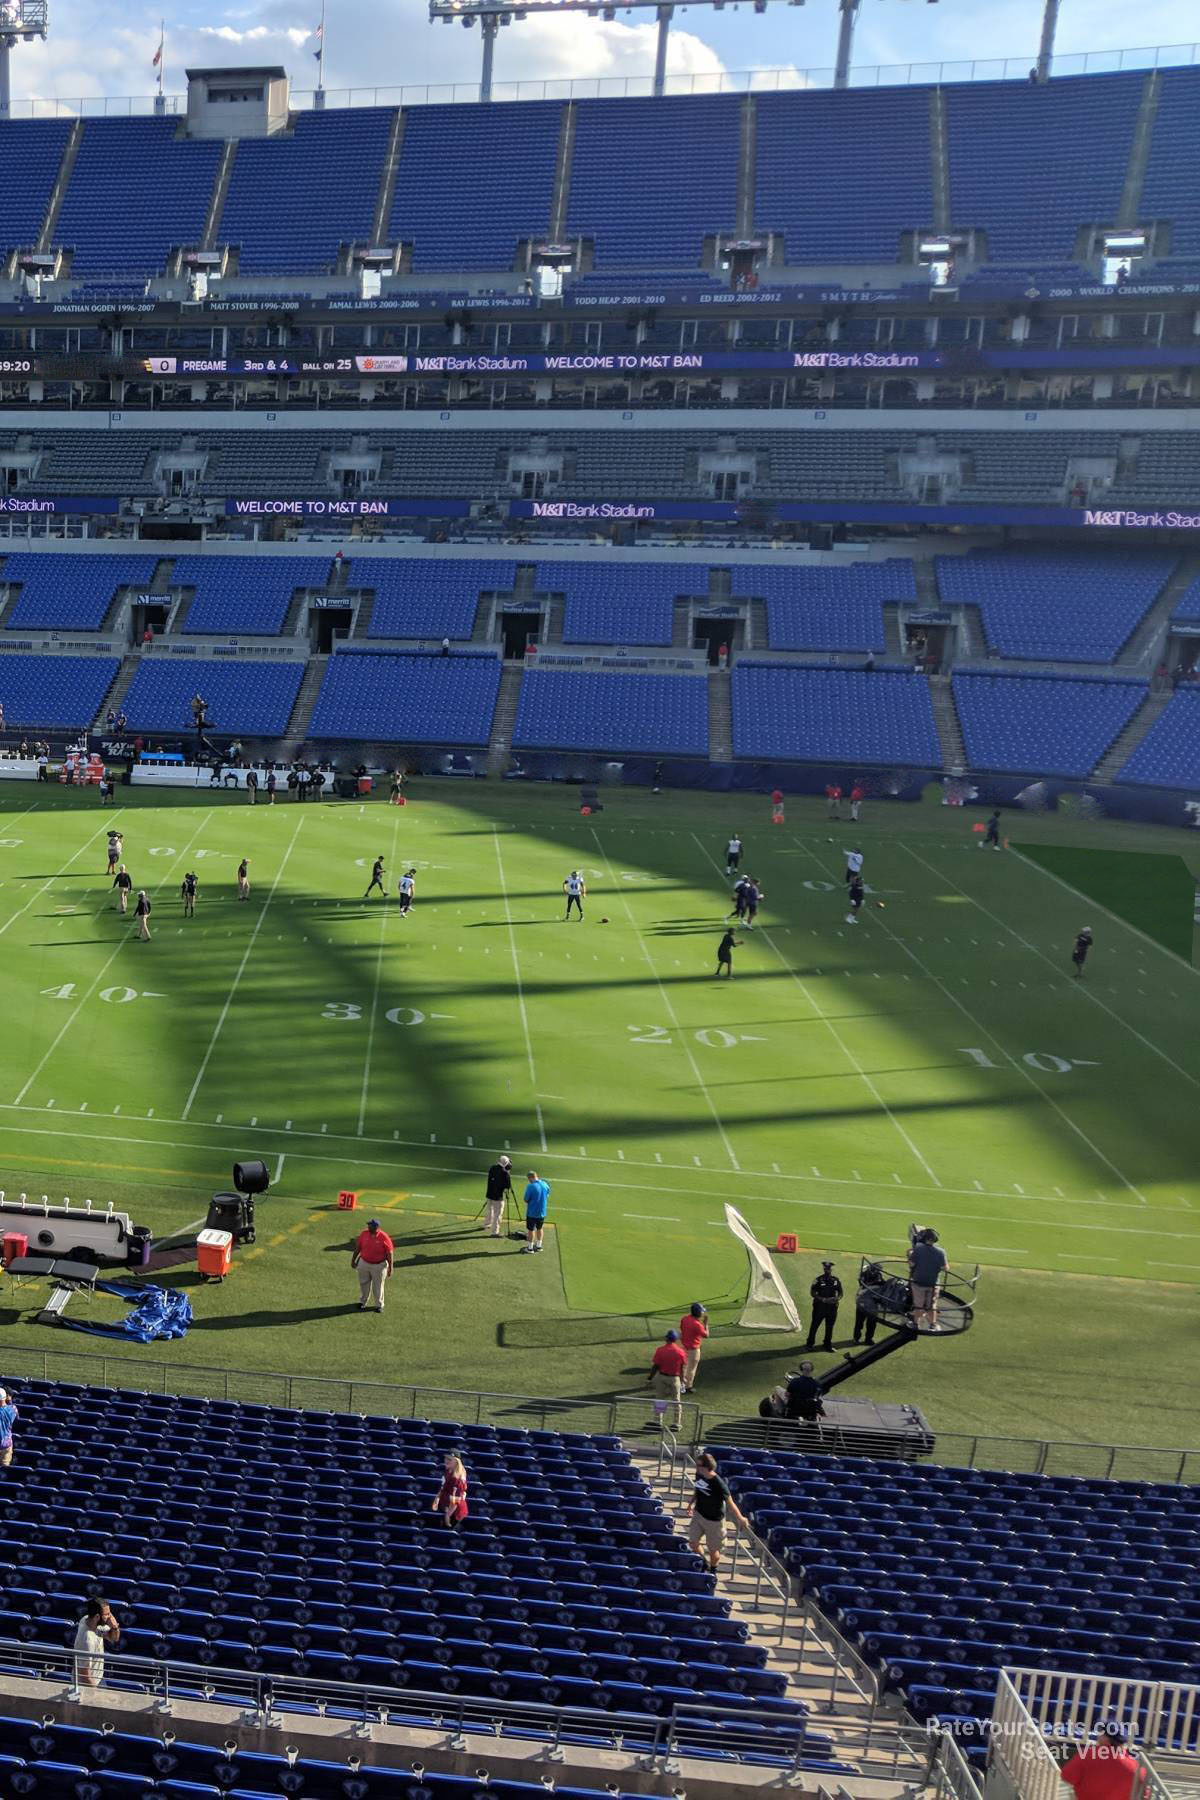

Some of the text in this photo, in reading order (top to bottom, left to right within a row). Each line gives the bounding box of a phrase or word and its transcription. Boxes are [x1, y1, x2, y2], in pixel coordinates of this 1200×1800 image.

[451, 300, 466, 308] RAY
[467, 299, 490, 307] LEWIS
[575, 297, 597, 305] TODD
[700, 294, 711, 302] ED
[712, 294, 735, 302] REED
[52, 305, 89, 313] JONATHAN
[90, 304, 116, 312] OGDEN
[328, 301, 352, 309] JAMAL
[159, 360, 170, 372] 0
[182, 360, 227, 372] PREGAME
[244, 360, 264, 371] 3RD
[267, 360, 277, 371] &
[280, 360, 289, 370] 4
[302, 362, 321, 370] BALL
[337, 359, 352, 370] 25
[415, 357, 528, 370] M&T Bank Stadium
[545, 356, 703, 369] WELCOME TO M&T BAN
[794, 353, 919, 367] M&T Bank Stadium
[8, 499, 55, 512] Stadium
[236, 501, 388, 514] WELCOME TO M&T BAN
[533, 503, 655, 517] M&T Bank Stadium
[1084, 510, 1125, 525] M&T
[1126, 512, 1164, 526] Bank
[101, 741, 127, 749] PLAY
[39, 982, 138, 1003] 40
[320, 1002, 426, 1026] 30
[627, 1024, 738, 1049] 20
[956, 1047, 1073, 1073] 10
[338, 1193, 354, 1207] 30
[780, 1236, 797, 1252] 20
